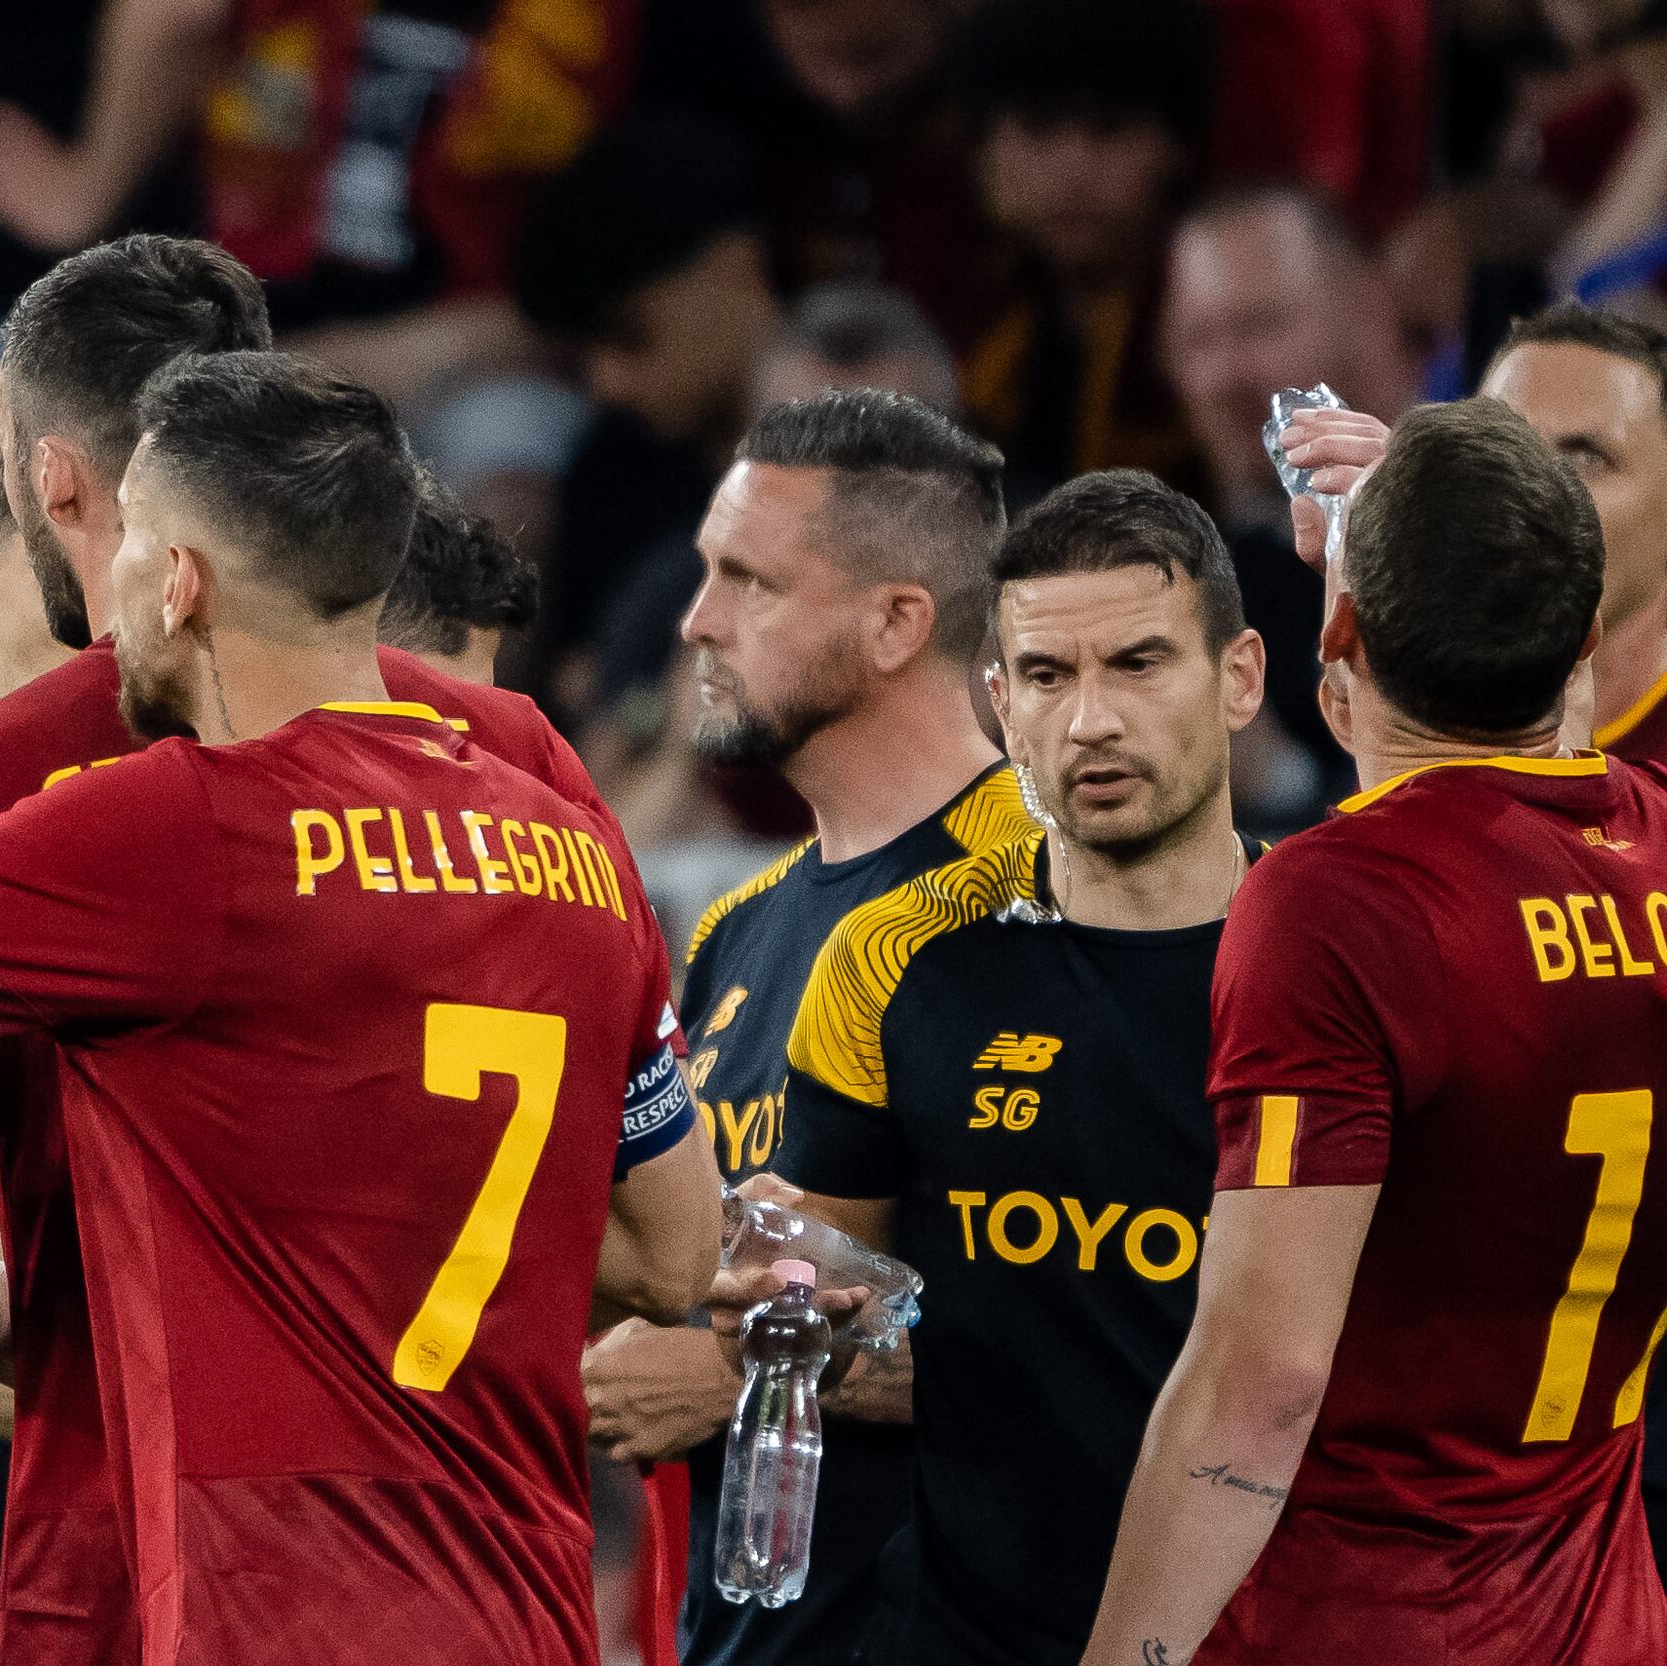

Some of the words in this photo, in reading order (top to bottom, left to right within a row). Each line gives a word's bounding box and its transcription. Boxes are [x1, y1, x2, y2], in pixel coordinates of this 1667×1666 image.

[291, 807, 627, 922] PELLEGRINI
[969, 1087, 1040, 1131] SG
[392, 1003, 566, 1392] 7
[948, 1190, 1210, 1282] TOYO
